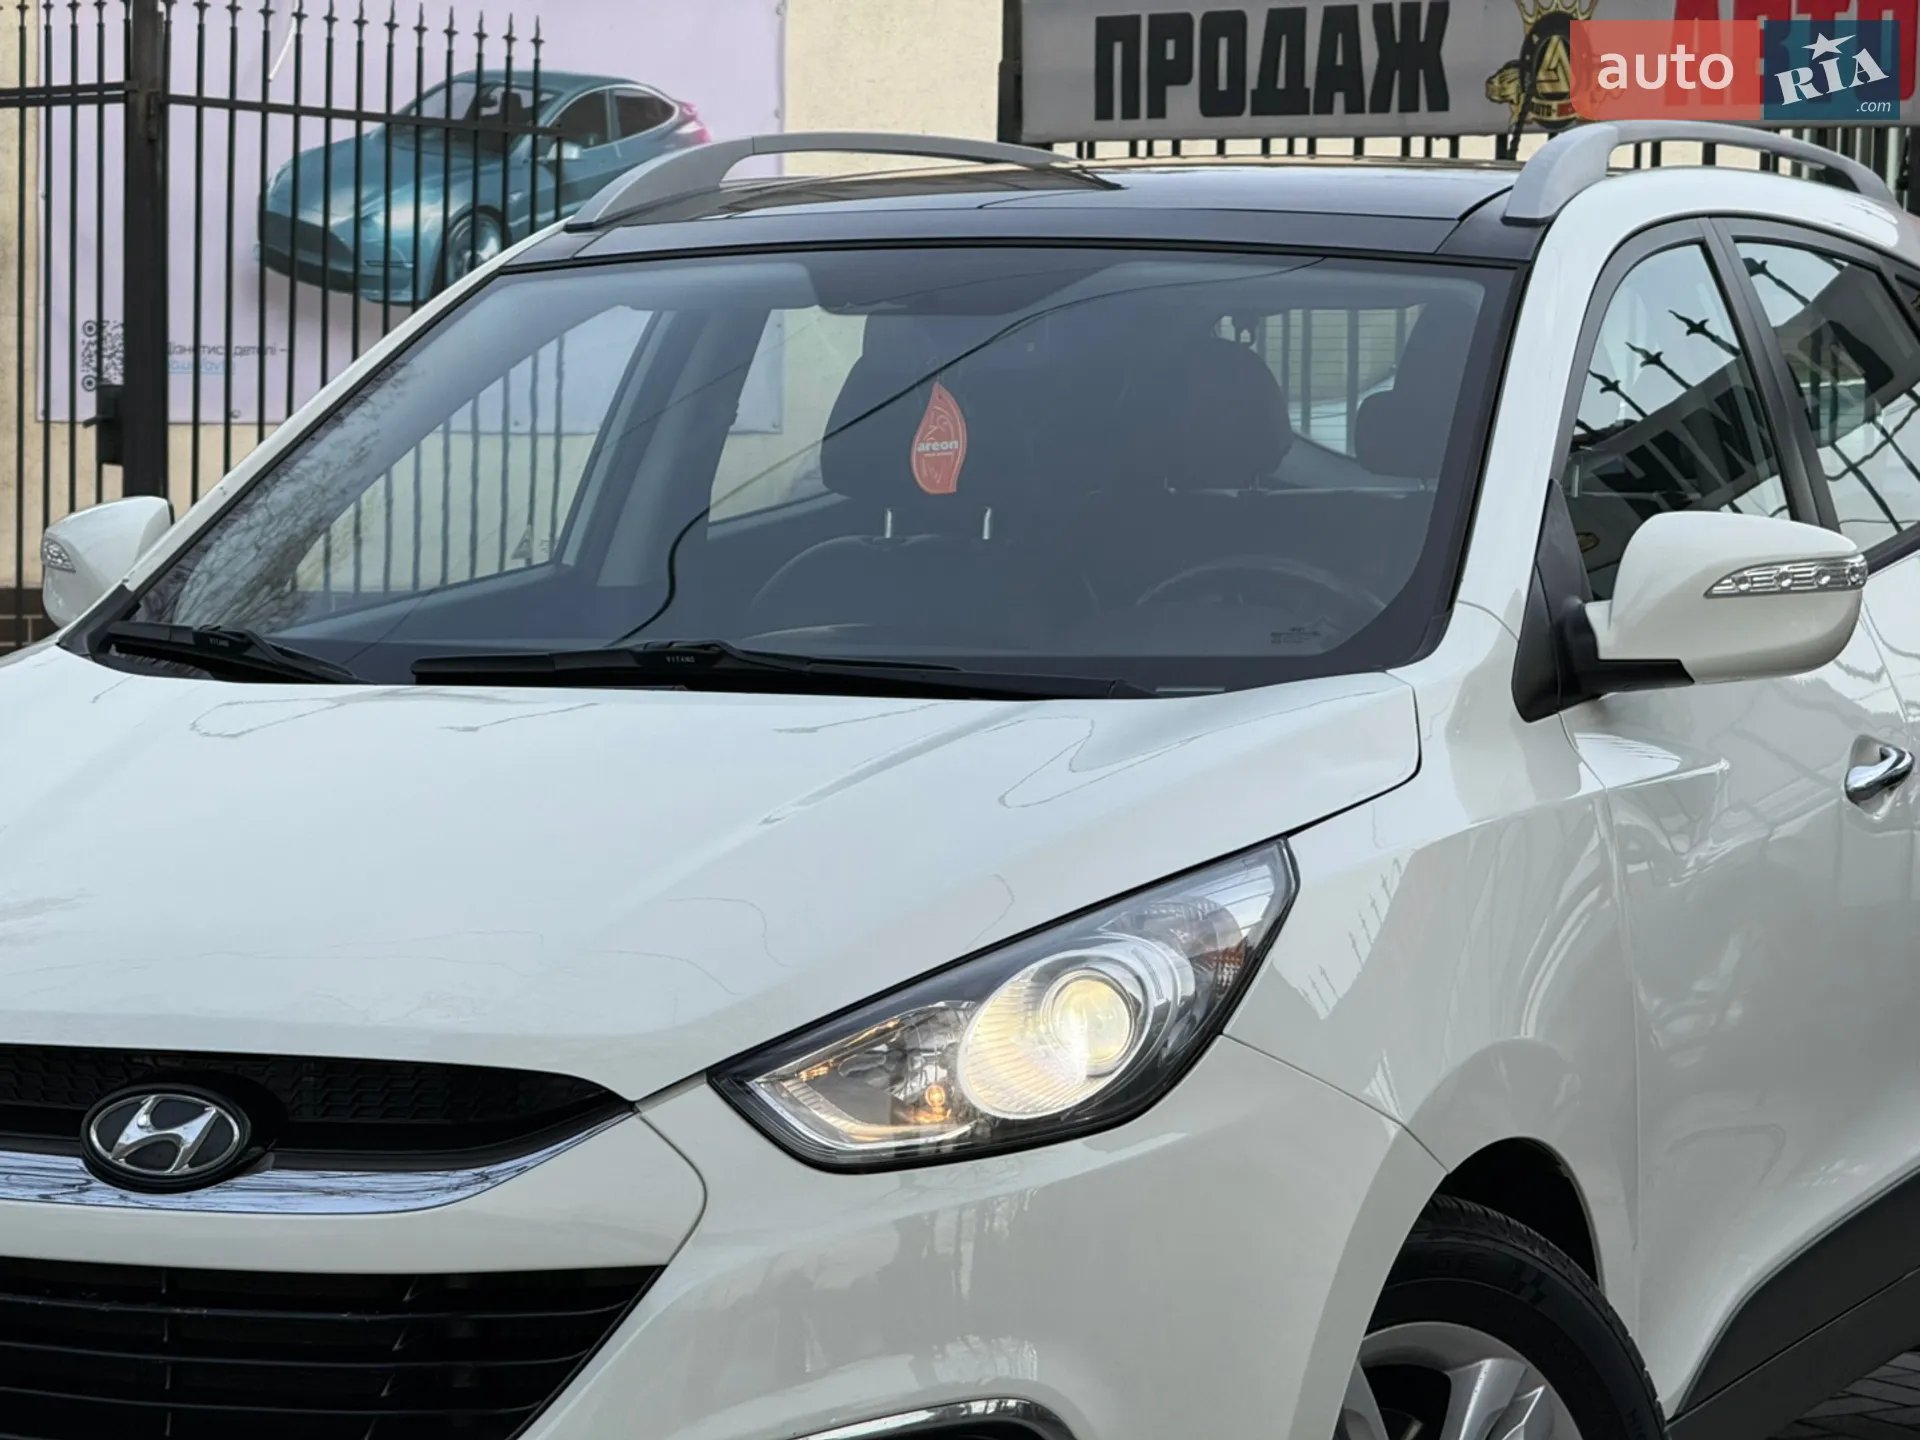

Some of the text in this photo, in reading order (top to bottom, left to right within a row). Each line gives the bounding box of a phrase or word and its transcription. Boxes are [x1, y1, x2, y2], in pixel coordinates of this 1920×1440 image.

[1094, 1, 1449, 121] ПРОДАЖ
[916, 440, 959, 452] areon
[665, 655, 696, 663] VITANO
